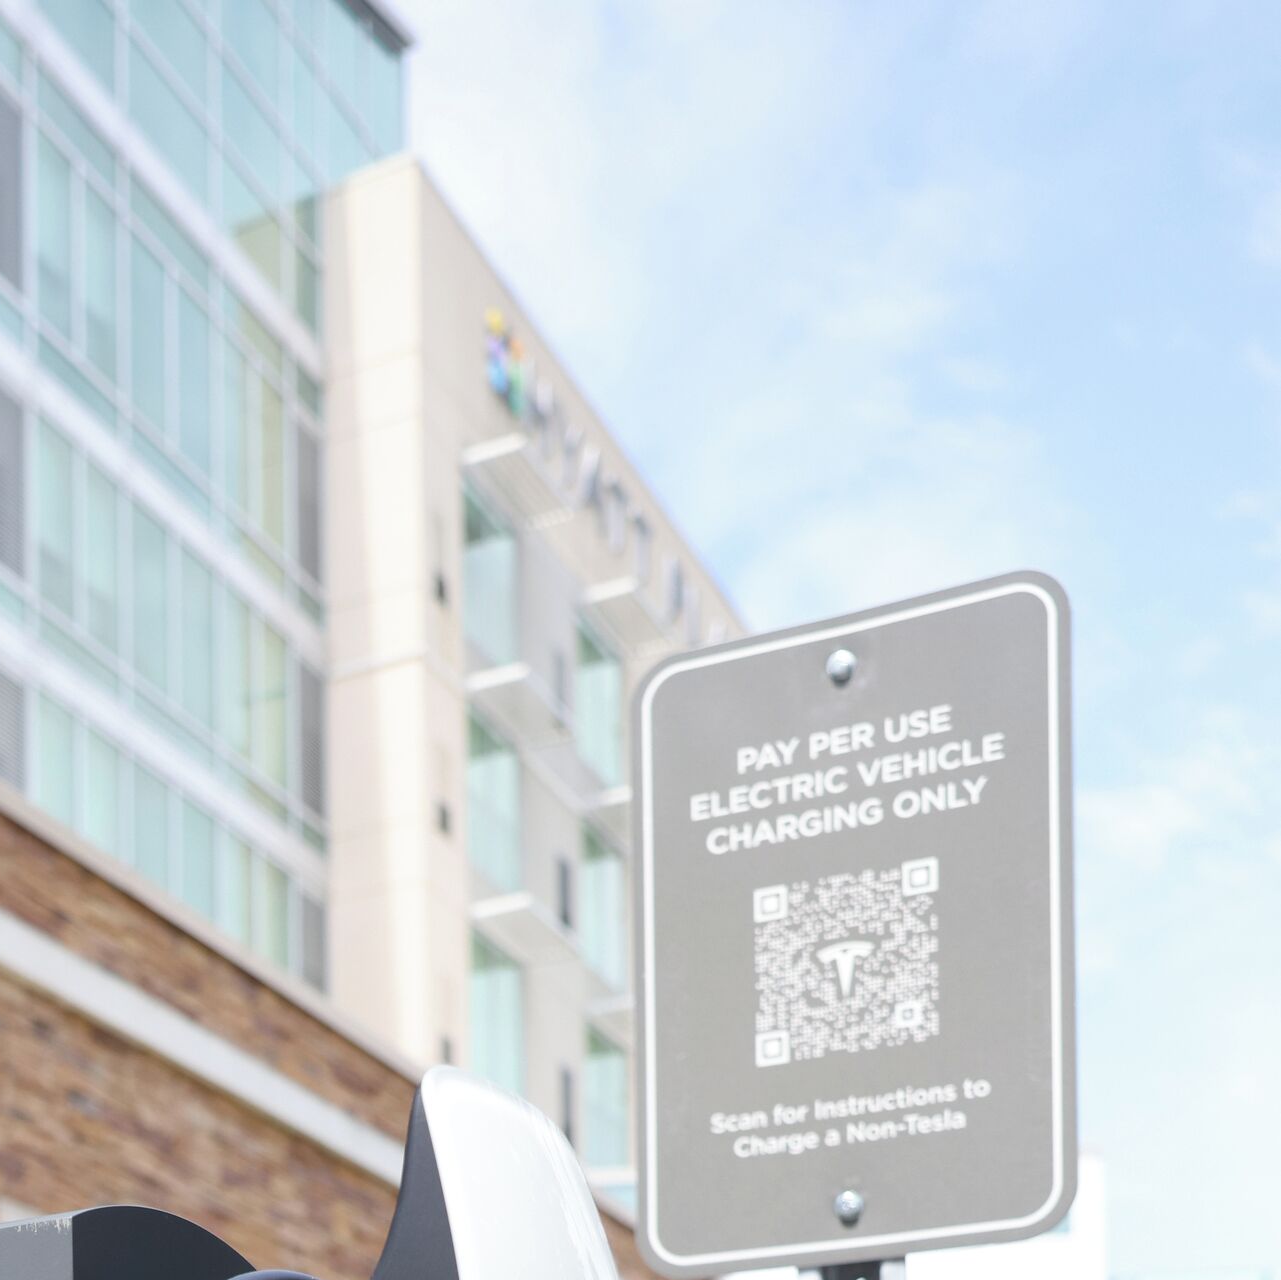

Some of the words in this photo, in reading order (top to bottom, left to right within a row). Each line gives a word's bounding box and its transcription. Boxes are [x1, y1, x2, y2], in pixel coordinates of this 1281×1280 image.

[736, 736, 800, 775] PAY
[808, 721, 876, 760] PER
[883, 703, 953, 743] USE
[689, 765, 849, 822] ELECTRIC
[856, 731, 1006, 787] VEHICLE
[705, 797, 884, 855] CHARGING
[892, 774, 988, 819] ONLY
[709, 1109, 769, 1134] Scan
[772, 1103, 810, 1126] for
[814, 1084, 958, 1121] Instructions
[962, 1077, 992, 1100] to
[733, 1130, 820, 1158] Charge
[824, 1128, 841, 1147] a
[846, 1107, 967, 1144] Non-Tesla
